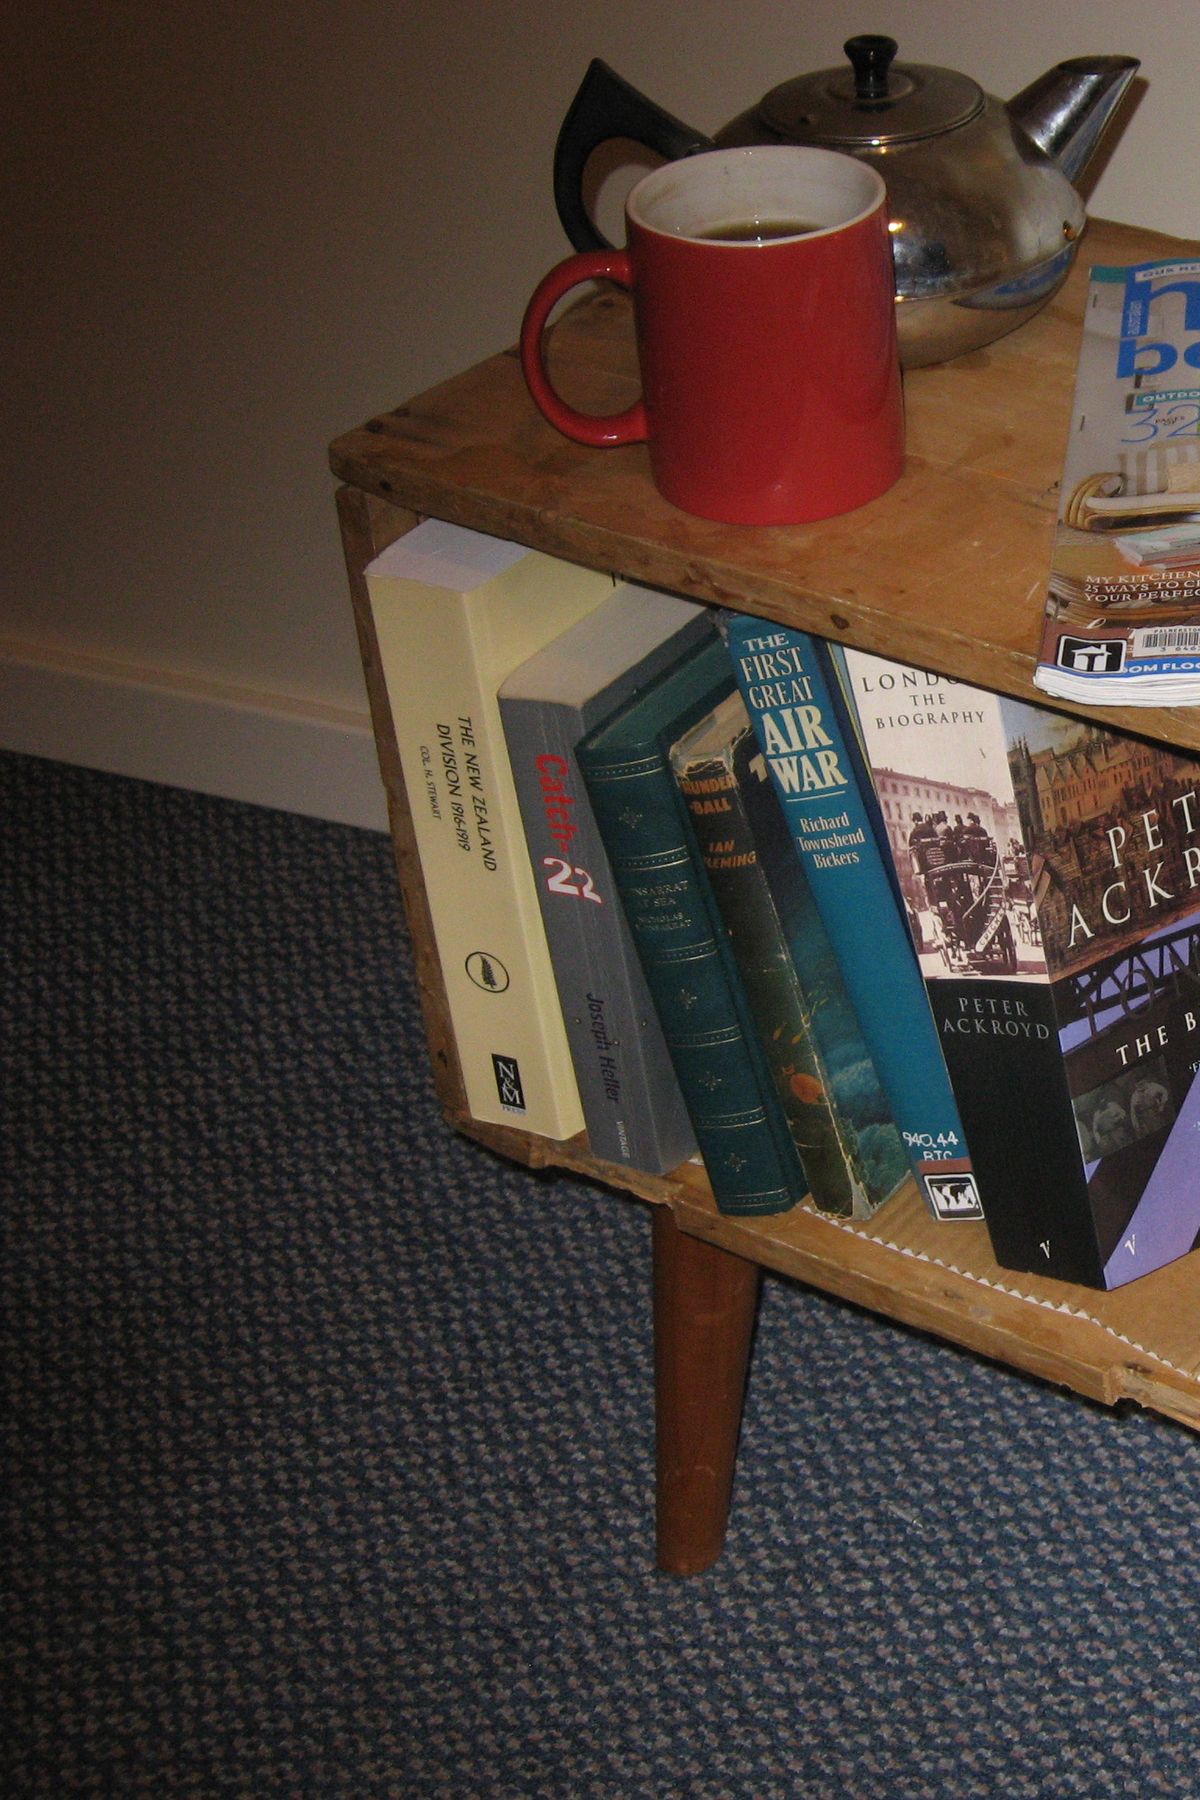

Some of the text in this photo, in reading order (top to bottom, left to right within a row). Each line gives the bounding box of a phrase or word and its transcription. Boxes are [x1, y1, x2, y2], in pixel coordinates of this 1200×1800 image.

[1084, 584, 1099, 593] 25
[1104, 583, 1149, 594] WAYS
[1154, 580, 1179, 590] TO
[1085, 575, 1114, 585] MY
[1118, 571, 1200, 584] KITCHEN
[1085, 592, 1132, 603] YOUR
[743, 632, 790, 652] THE
[739, 646, 804, 683] FIRST
[749, 676, 814, 710] GREAT
[909, 692, 947, 708] THE
[761, 704, 833, 756] AIR
[875, 711, 986, 730] BIOGRAPHY
[768, 750, 849, 794] WAR
[436, 722, 471, 852] DIVISION 1916-1919
[457, 716, 498, 872] THE NEW ZEALAND
[426, 780, 442, 821] STEWART
[799, 811, 850, 833] Richard
[709, 840, 735, 852] IAN
[797, 829, 866, 852] Townshend
[812, 851, 860, 869] Bickers
[958, 997, 1028, 1017] PETER
[942, 1018, 1049, 1040] ACKROYD
[586, 992, 621, 1105] Joseph Heller
[1115, 1026, 1170, 1066] THE
[616, 1120, 631, 1159] VINTAGE
[902, 1130, 960, 1148] 940.44
